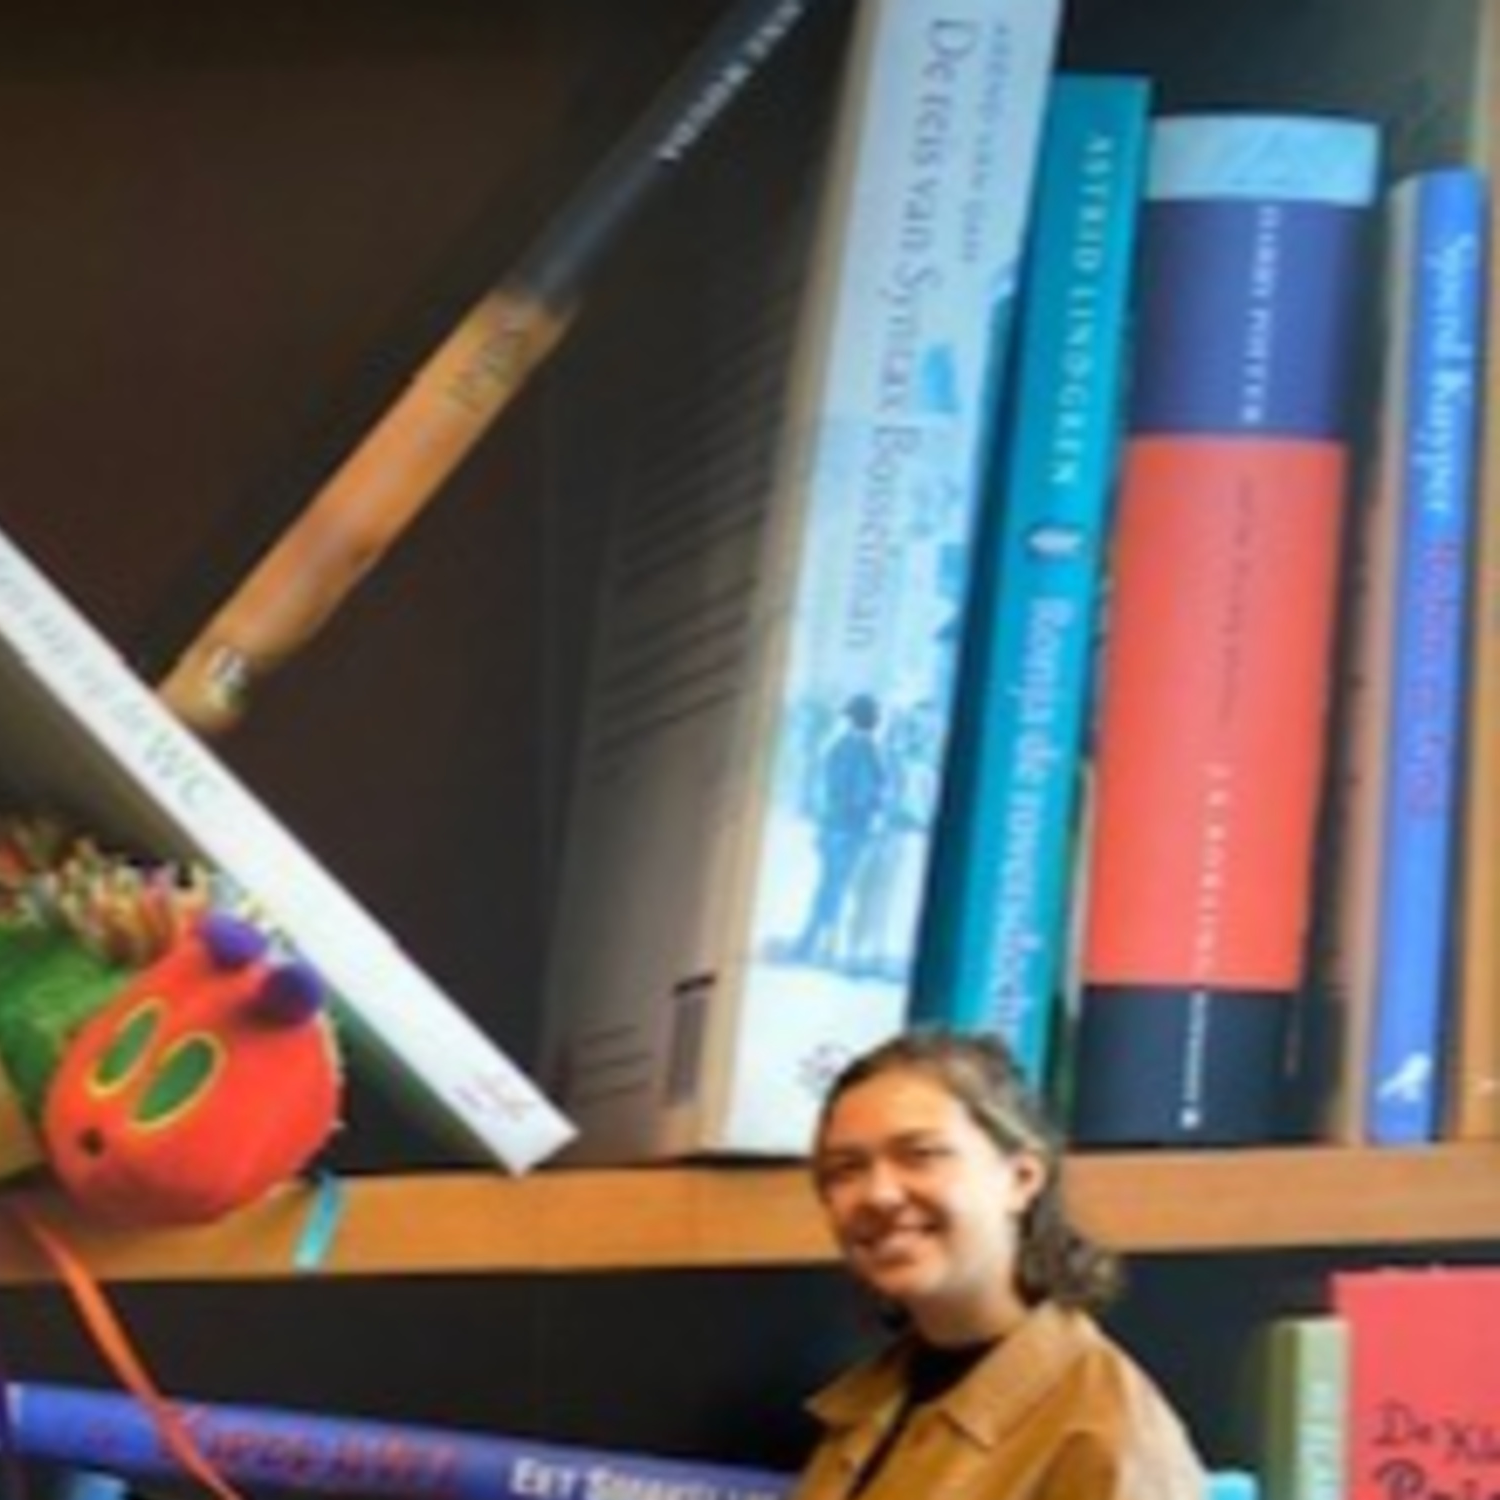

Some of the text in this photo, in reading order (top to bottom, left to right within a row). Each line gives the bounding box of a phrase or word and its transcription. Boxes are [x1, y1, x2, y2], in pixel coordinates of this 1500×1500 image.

[842, 12, 978, 652] De reis van Syntax Bosselman
[1050, 134, 1115, 485] ASTRID LINDGREN
[1236, 306, 1272, 425] POTTER
[1410, 229, 1477, 516] Sjoerd Kuyper
[1014, 594, 1072, 727] Ronja
[139, 730, 218, 810] WC
[1018, 733, 1057, 785] de
[1370, 1399, 1433, 1448] De
